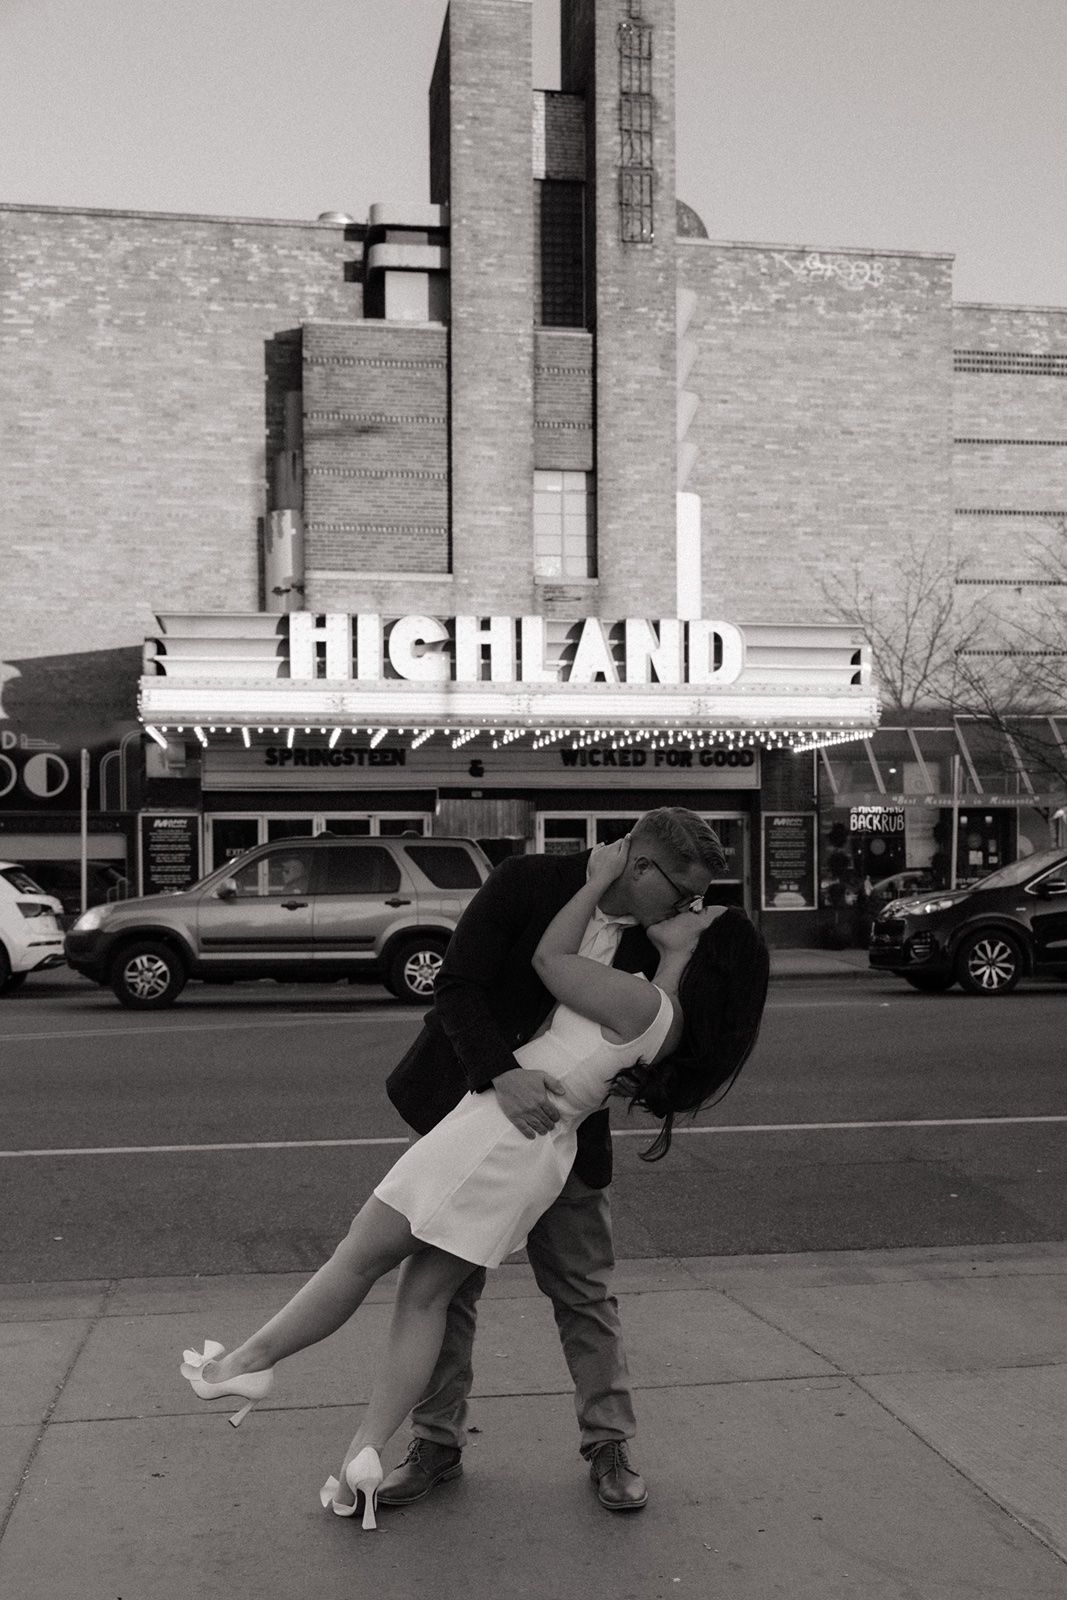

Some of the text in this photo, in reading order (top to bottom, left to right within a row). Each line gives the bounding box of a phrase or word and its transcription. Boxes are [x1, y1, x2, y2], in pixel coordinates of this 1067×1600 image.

[288, 612, 746, 685] HIGHLAND
[264, 748, 406, 767] SPRINGSTEEN
[560, 749, 754, 768] WICKED FOR GOOD
[850, 814, 905, 832] BACKRUB
